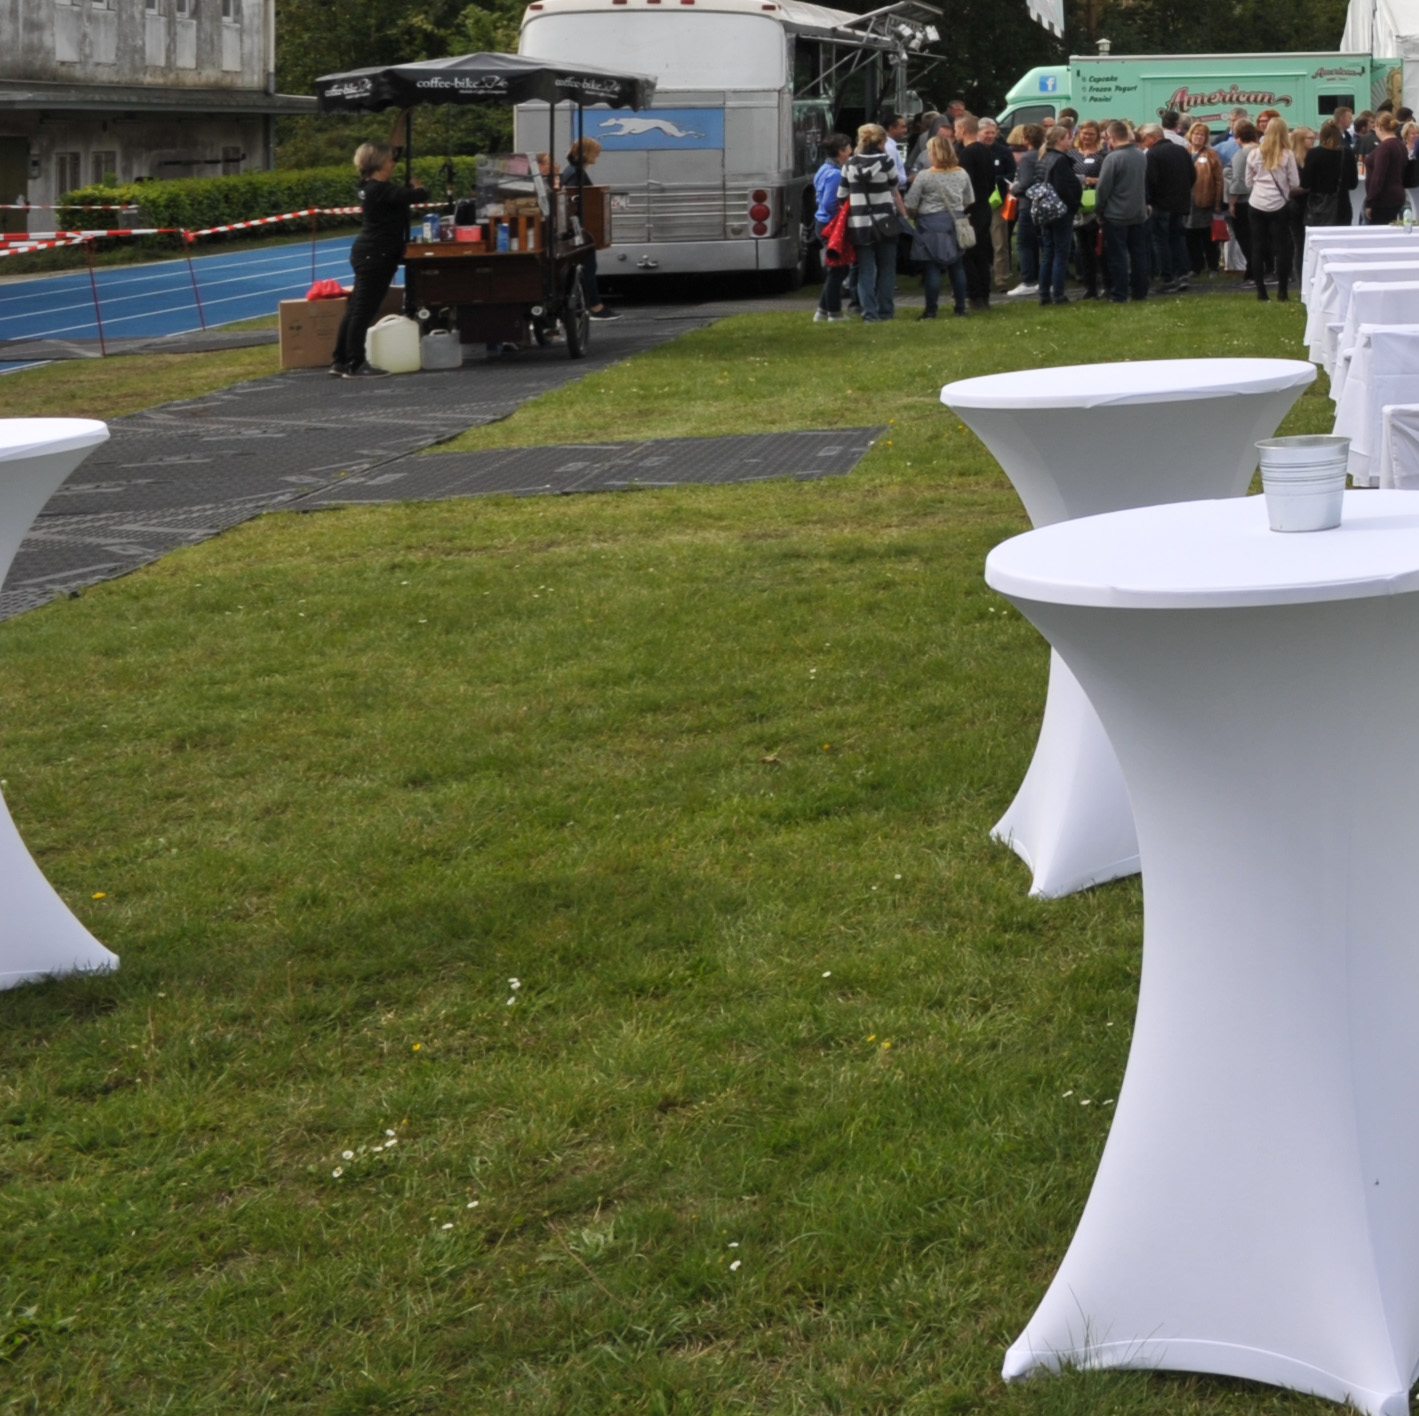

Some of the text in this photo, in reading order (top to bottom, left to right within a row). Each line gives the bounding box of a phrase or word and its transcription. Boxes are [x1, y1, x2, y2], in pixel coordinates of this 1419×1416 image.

[416, 76, 479, 89] coffee-bike
[1088, 75, 1118, 84] Cupcake
[1157, 84, 1292, 115] American
